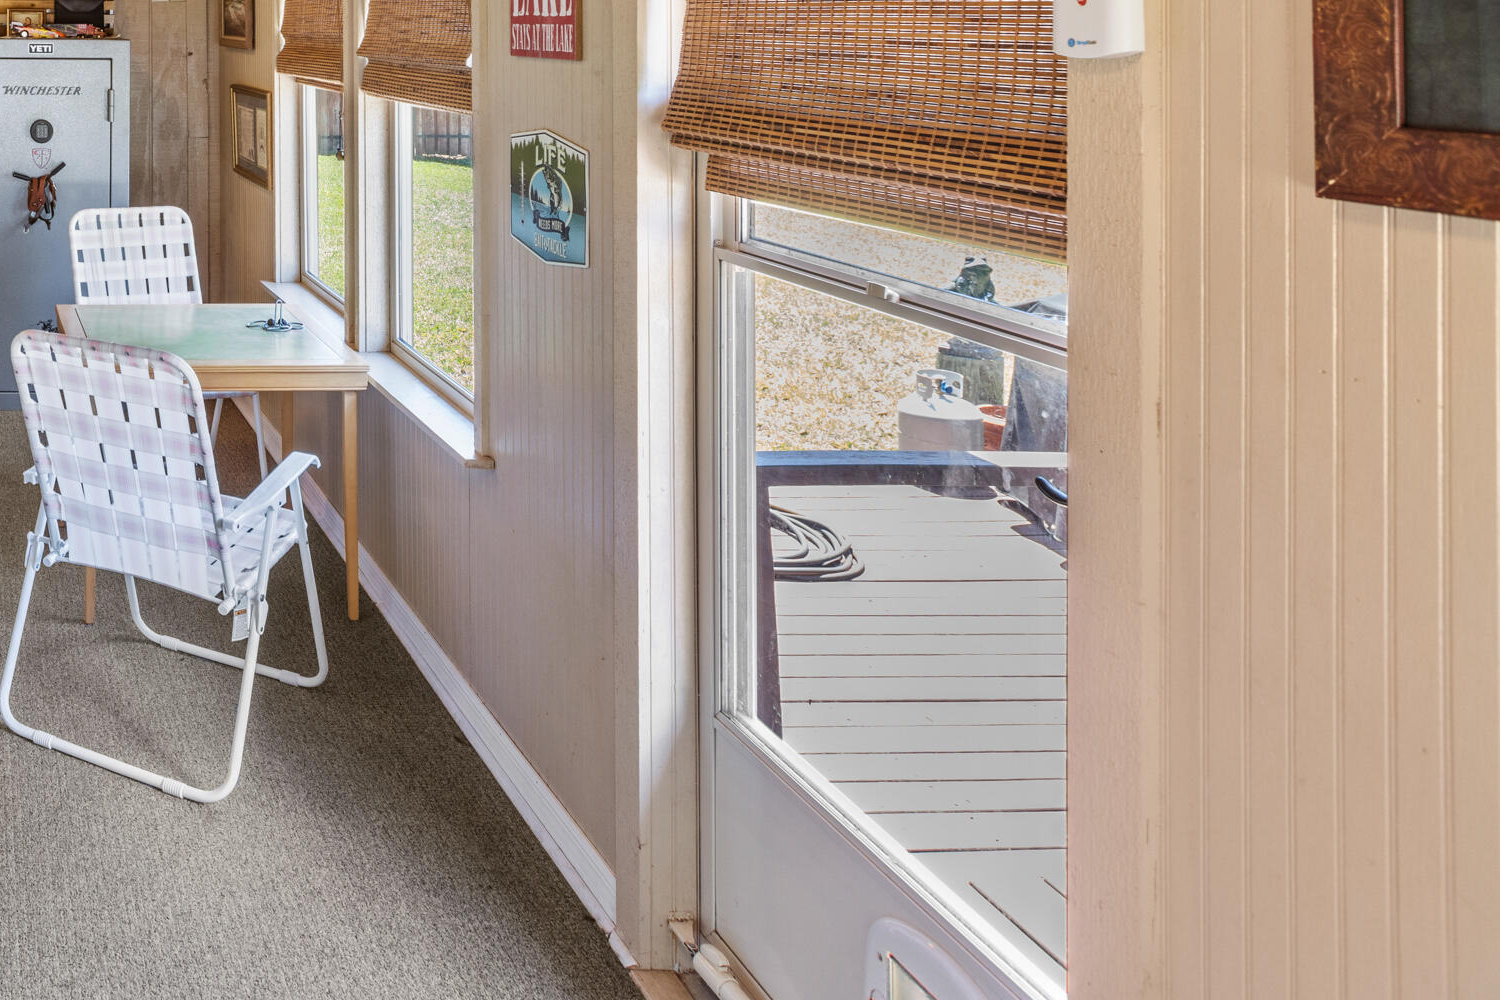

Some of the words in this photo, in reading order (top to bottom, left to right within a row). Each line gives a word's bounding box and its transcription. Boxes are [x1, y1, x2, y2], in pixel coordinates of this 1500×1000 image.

[512, 23, 531, 50] STAYS
[532, 23, 541, 51] AT
[541, 23, 555, 52] THE
[555, 23, 573, 53] LAKE
[29, 44, 52, 54] YETI
[2, 85, 83, 96] WINCHESTER
[535, 144, 567, 174] LIFE
